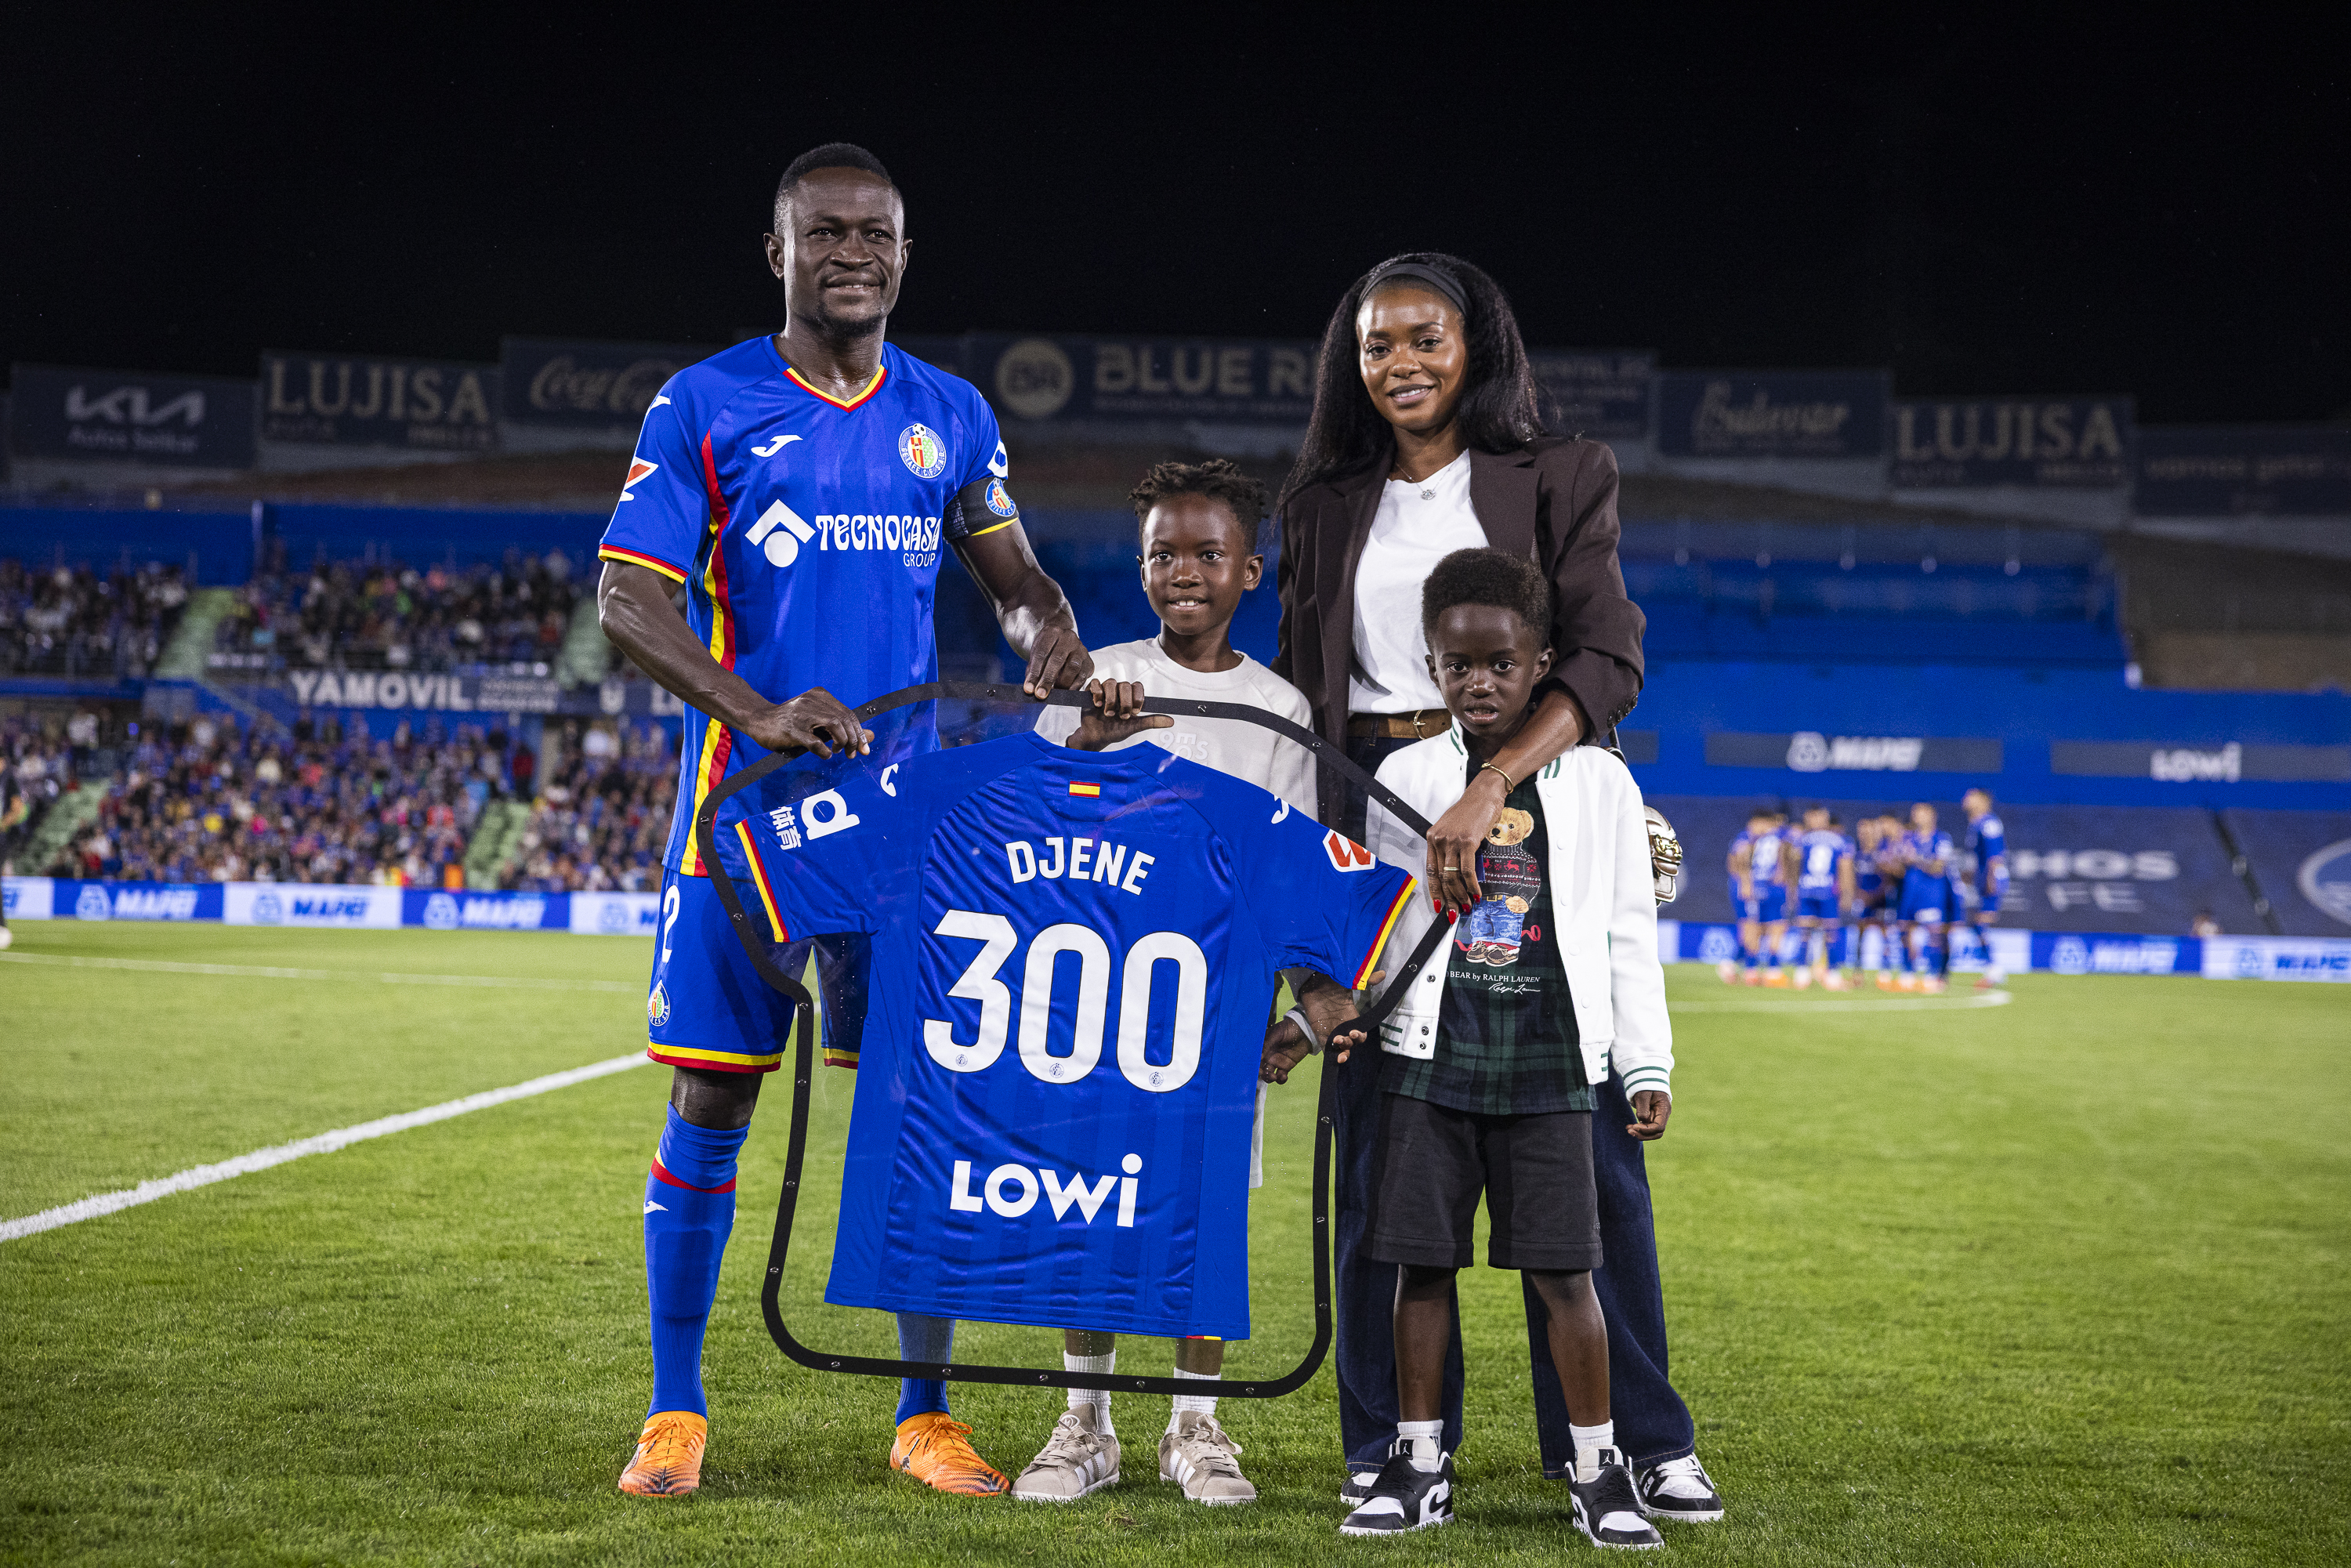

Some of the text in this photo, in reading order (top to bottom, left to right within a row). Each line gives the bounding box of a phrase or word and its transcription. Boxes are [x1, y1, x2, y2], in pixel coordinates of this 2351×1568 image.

[268, 359, 491, 423] LUJISA
[1093, 343, 1253, 396] BLUE
[1896, 403, 2125, 461] LUJISA
[901, 447, 921, 474] GETAFE
[987, 499, 1006, 515] GETAFE
[815, 514, 941, 552] TECNOCASA
[904, 552, 936, 567] GROUP
[288, 672, 473, 710] YAMOVIL
[1005, 836, 1156, 896] DJENE
[662, 885, 680, 963] 2
[1450, 970, 1471, 979] BEAR
[1473, 972, 1481, 982] by
[1483, 973, 1509, 983] RALPH
[924, 910, 1208, 1092] 300
